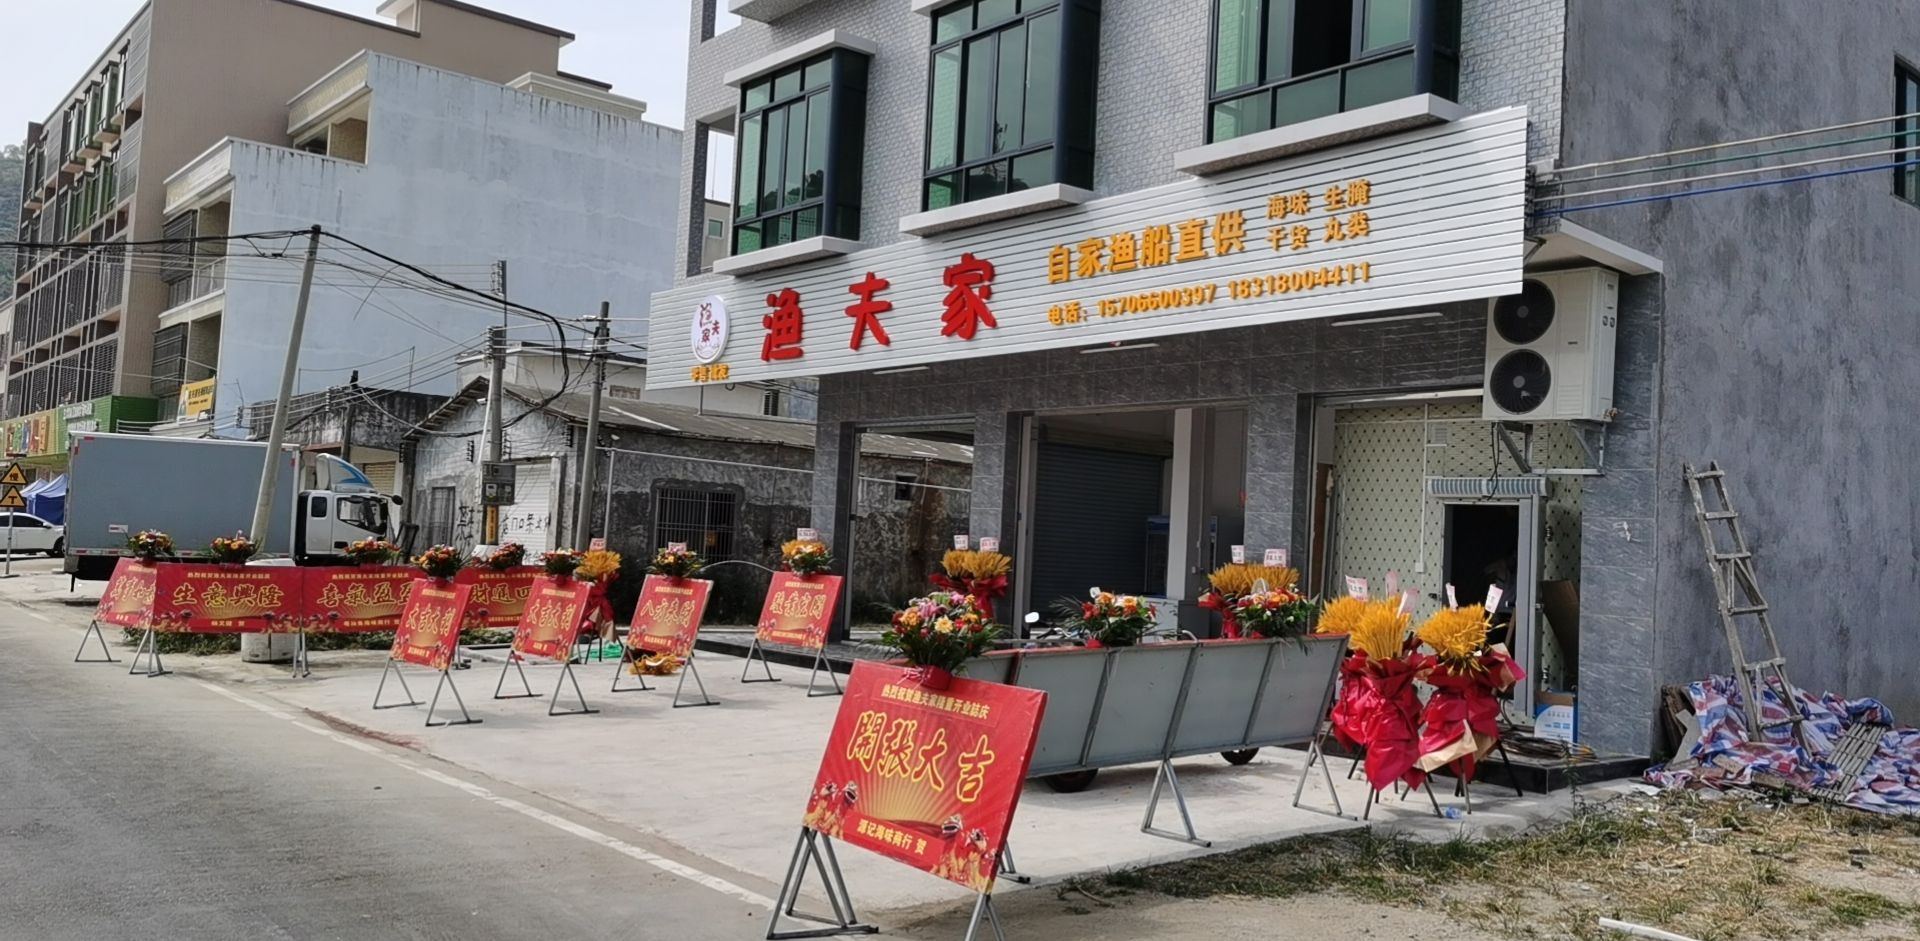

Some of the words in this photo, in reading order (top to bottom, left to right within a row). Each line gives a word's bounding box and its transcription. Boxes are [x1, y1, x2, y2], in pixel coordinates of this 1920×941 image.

[1266, 190, 1310, 220] 海味
[1323, 178, 1371, 211] 生腌
[1047, 209, 1246, 285] 自家渔船直供
[1267, 224, 1309, 251] 干货
[1323, 212, 1370, 242] 丸类
[760, 252, 997, 363] 渔夫家
[1098, 284, 1217, 318] 15706600397
[1228, 261, 1371, 300] 18318004411
[172, 581, 284, 608] 生意興隆
[405, 602, 456, 637] 大吉大利
[526, 599, 577, 631] 大吉大利
